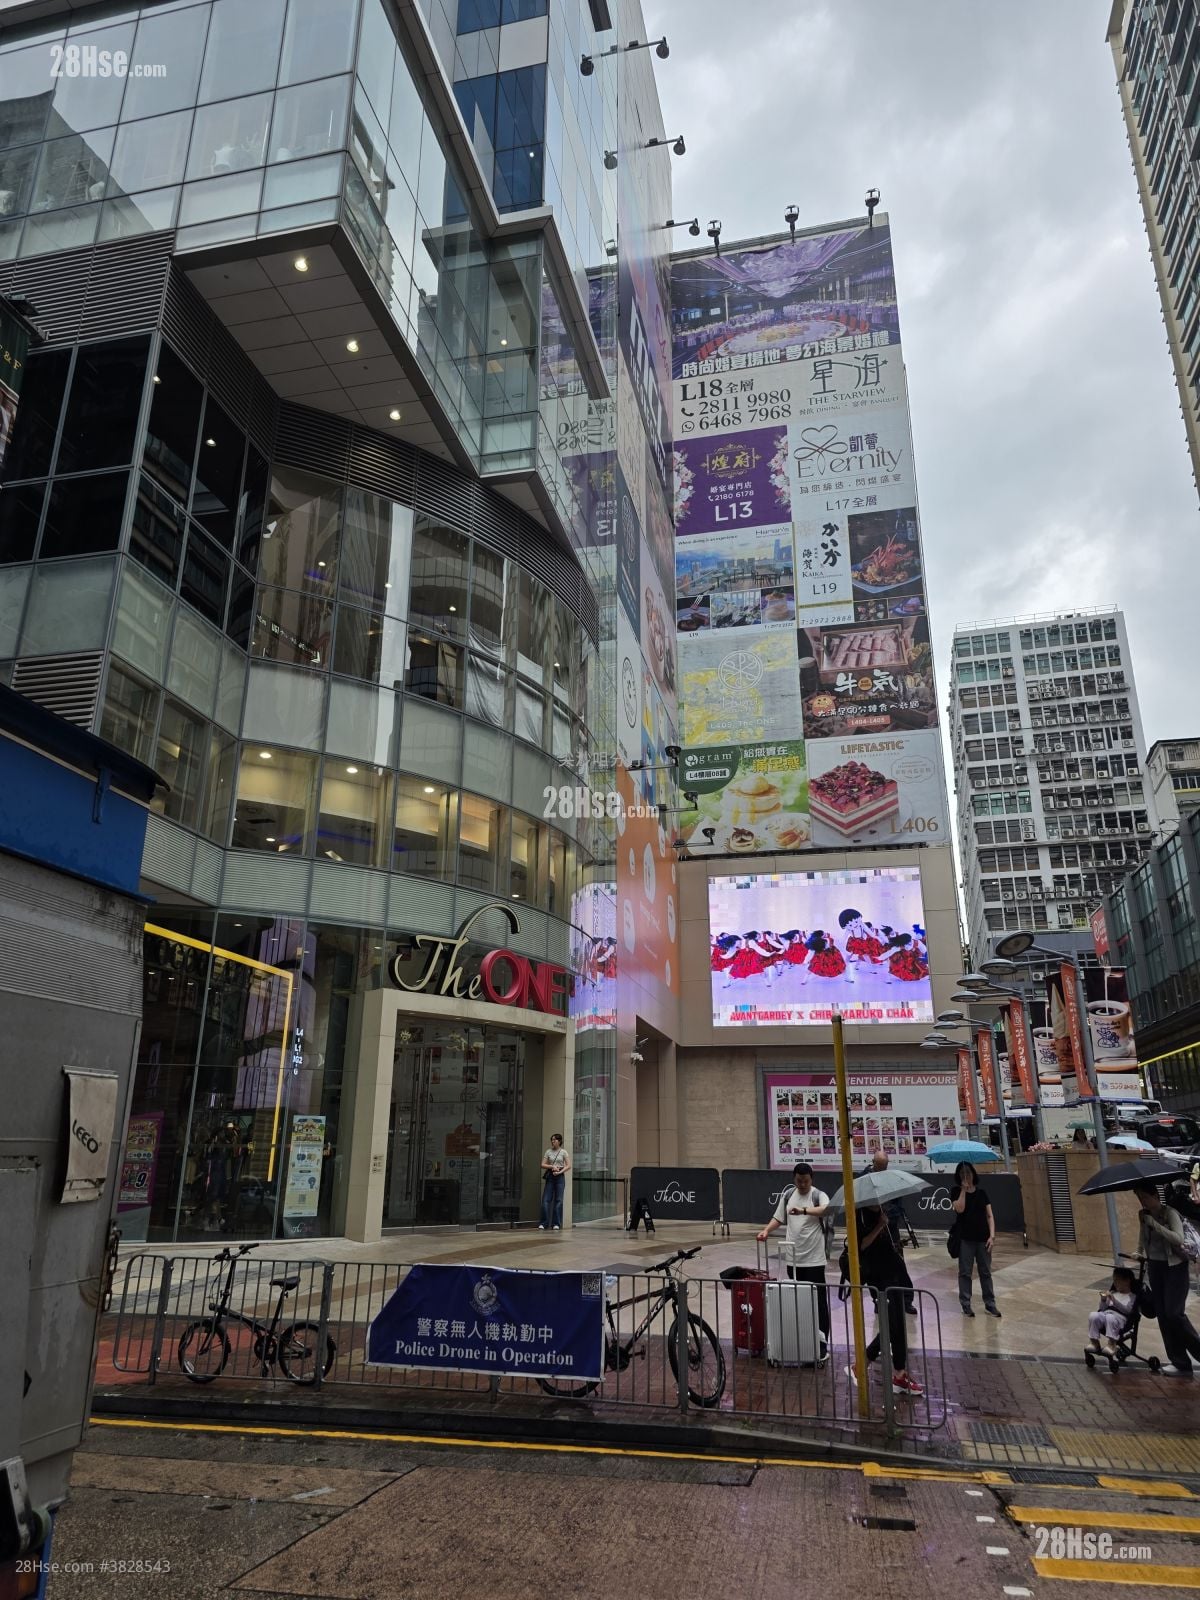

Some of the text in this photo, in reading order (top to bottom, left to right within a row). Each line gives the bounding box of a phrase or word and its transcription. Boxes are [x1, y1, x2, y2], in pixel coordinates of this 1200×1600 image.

[699, 388, 791, 416] 2811 9980
[808, 386, 886, 406] THE STARVIEW
[699, 403, 792, 431] 6468 7968
[714, 500, 753, 522] L13
[813, 582, 837, 595] L19
[840, 740, 905, 755] LIFETASTIC
[698, 752, 732, 765] gram
[889, 815, 939, 834] L406
[388, 903, 567, 1016] The ONE
[809, 1009, 833, 1021] CHIB
[886, 1006, 915, 1019] CHAN
[891, 1076, 902, 1085] IN
[904, 1075, 957, 1085] FLAVOURS
[72, 1119, 99, 1154] LEEO
[416, 1317, 554, 1345] 警察無人機執勤中
[395, 1339, 574, 1366] Police Drone in Operation
